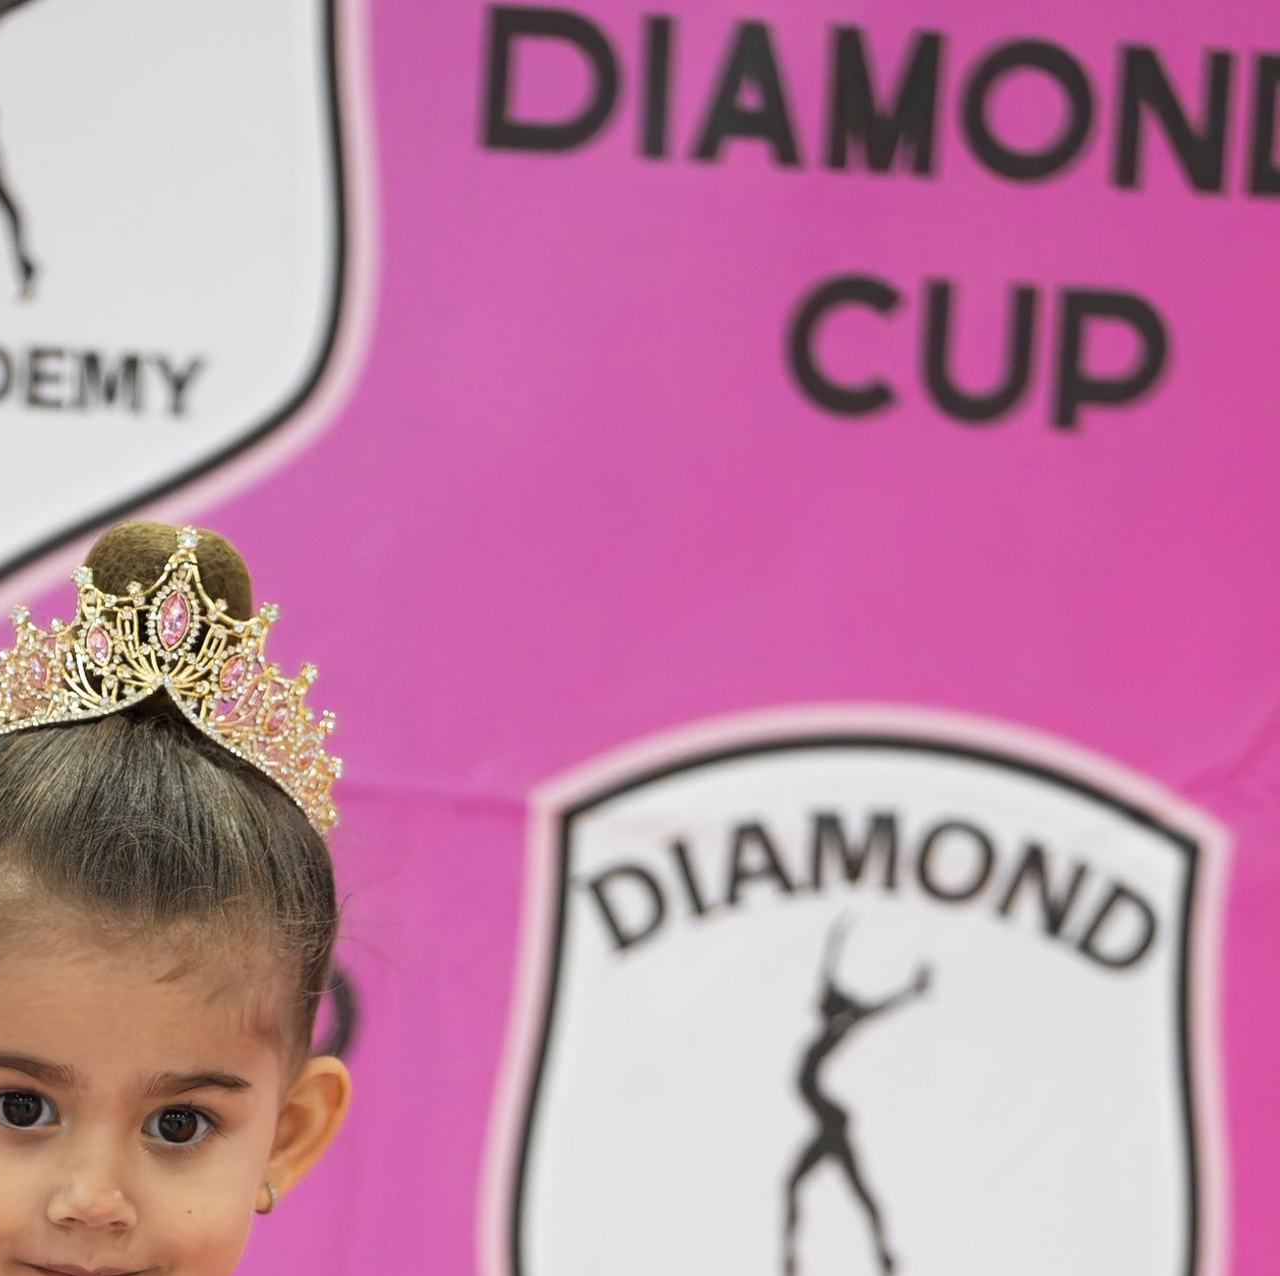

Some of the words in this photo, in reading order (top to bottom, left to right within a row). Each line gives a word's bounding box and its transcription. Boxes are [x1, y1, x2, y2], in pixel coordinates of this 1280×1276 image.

[479, 5, 1280, 198] DIAMON
[784, 271, 1173, 432] CUP
[586, 809, 1160, 971] DIAMOND
